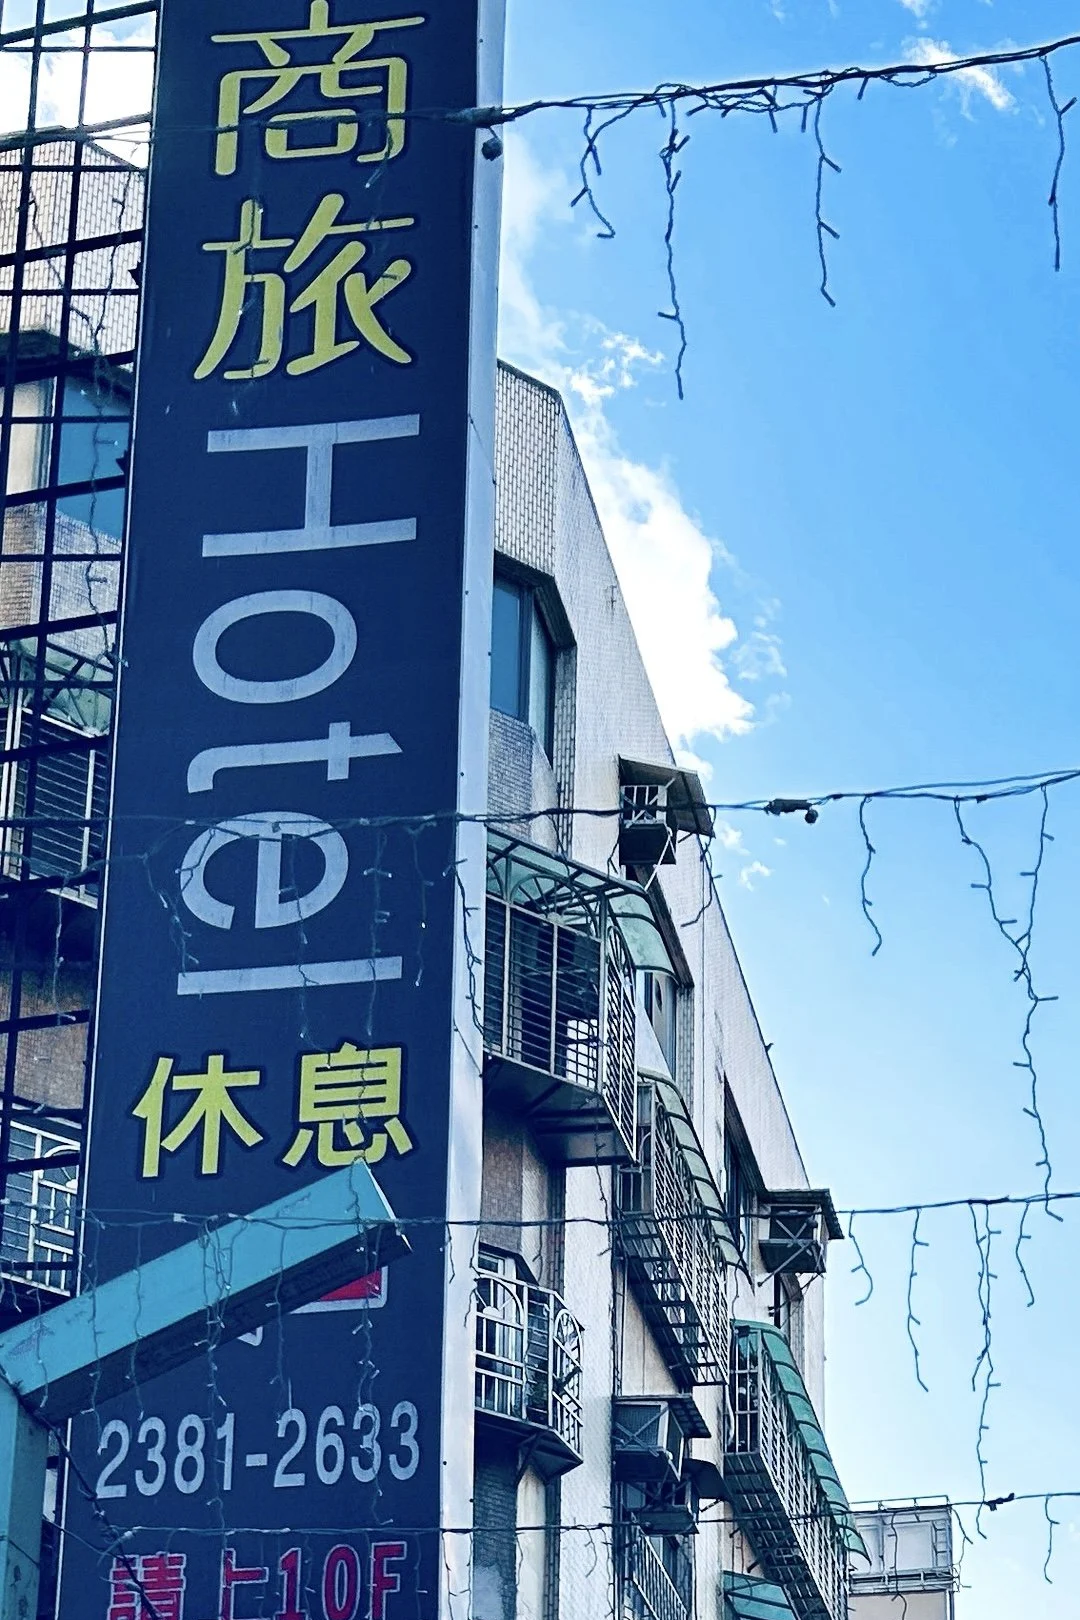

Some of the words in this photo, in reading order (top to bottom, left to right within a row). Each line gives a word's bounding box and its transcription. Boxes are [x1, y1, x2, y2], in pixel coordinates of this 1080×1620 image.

[195, 0, 426, 380] 商旅
[178, 413, 421, 996] Hotel
[132, 1043, 413, 1178] 休息
[96, 1400, 422, 1500] 2381-2633
